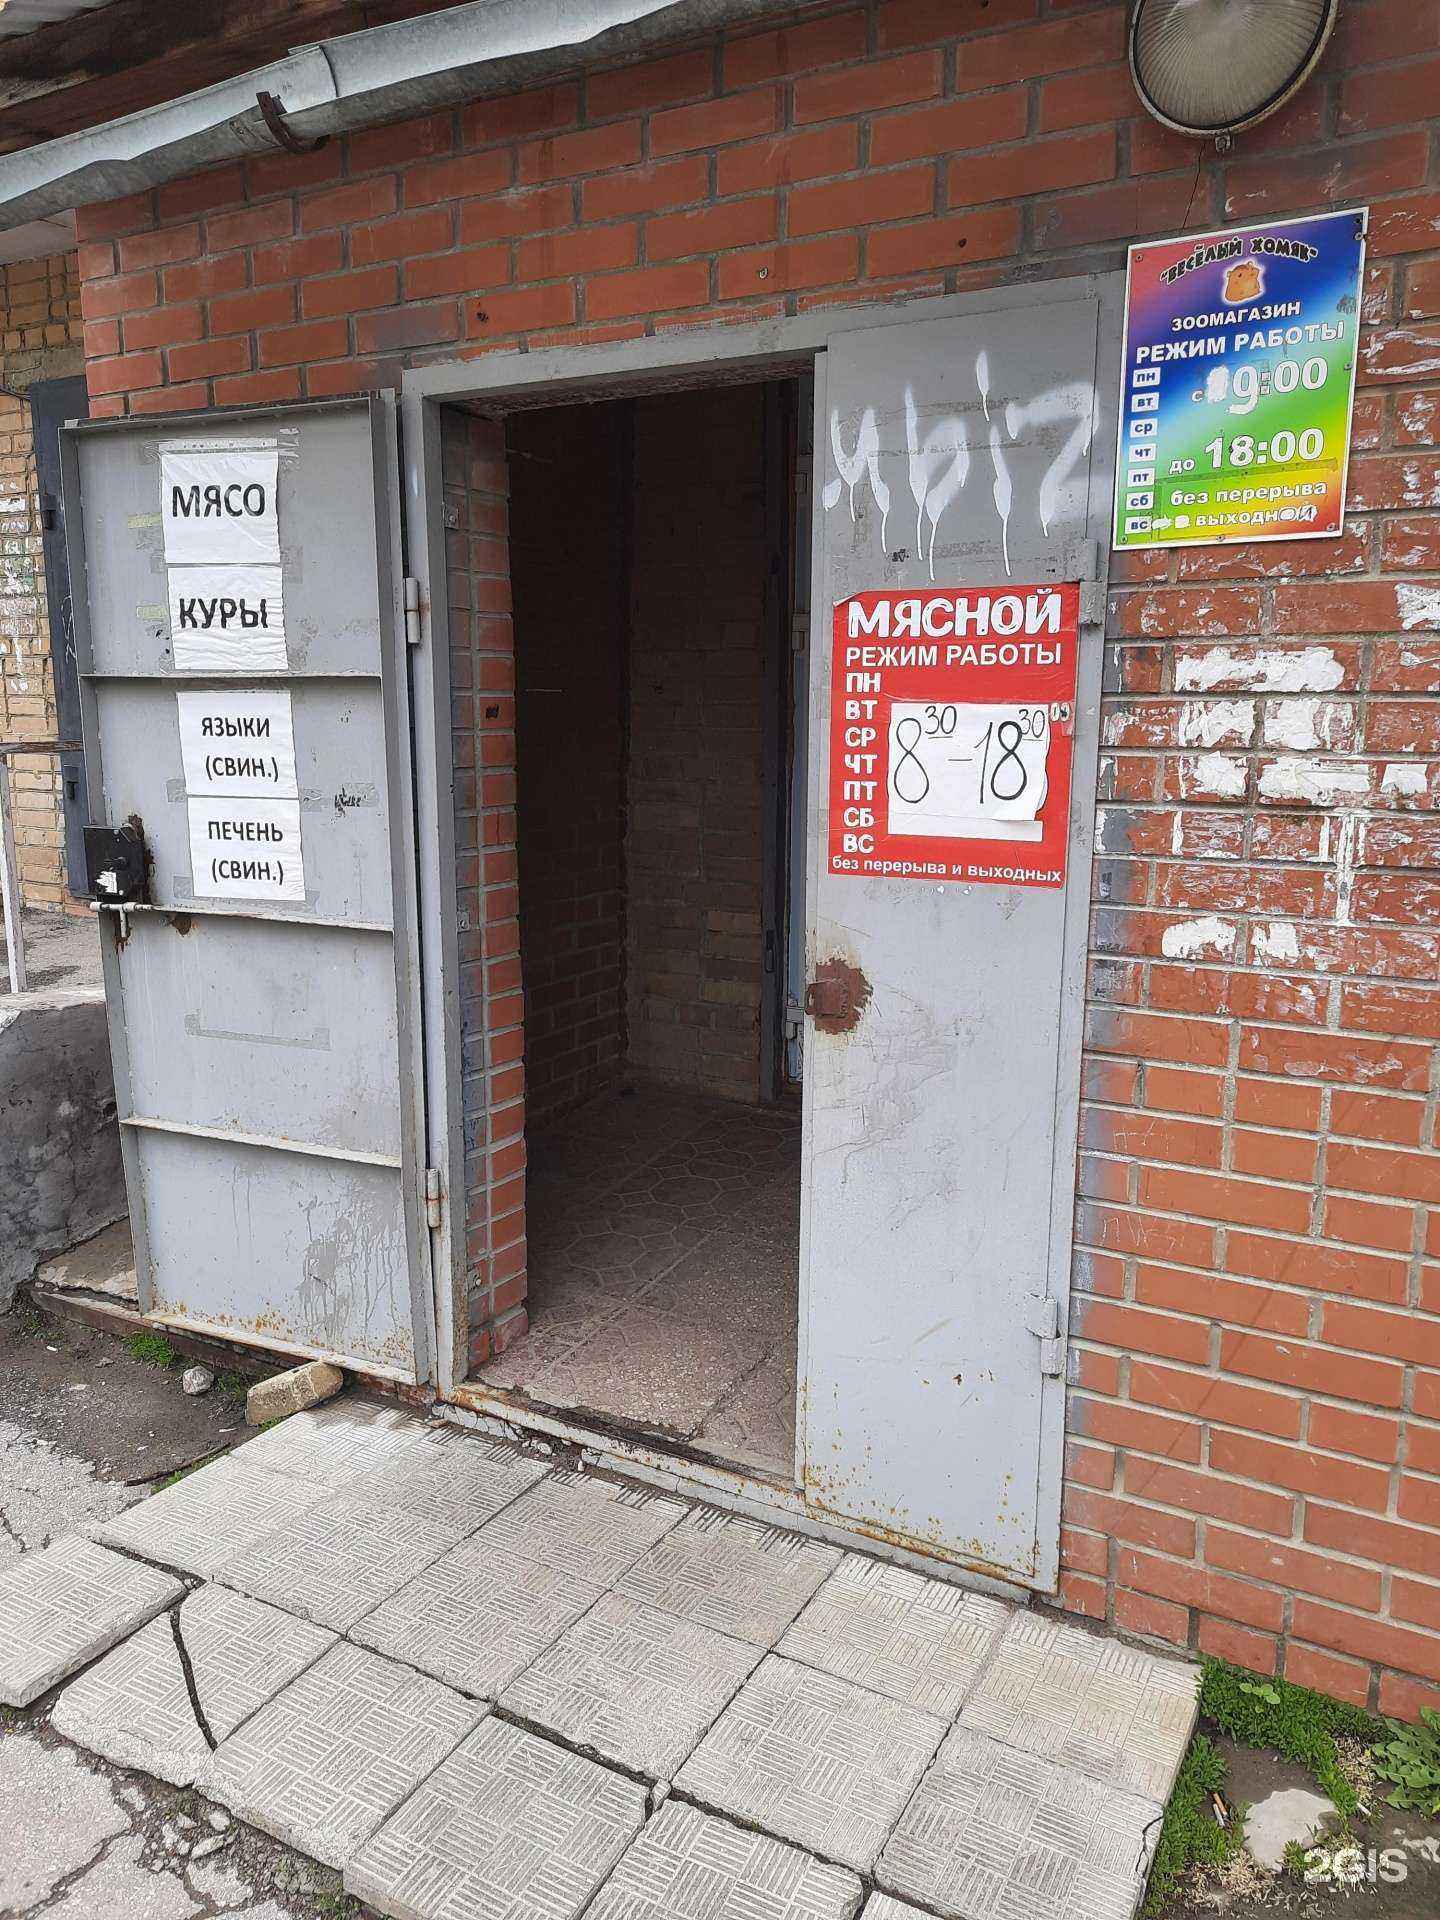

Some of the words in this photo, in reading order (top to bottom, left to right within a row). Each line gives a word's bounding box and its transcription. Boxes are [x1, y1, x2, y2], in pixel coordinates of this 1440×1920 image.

[1171, 298, 1302, 333] ЗООМАГАЗИН
[1136, 335, 1226, 365] РЕЖИМ
[1234, 320, 1345, 353] РАБОТЫ
[1169, 457, 1196, 476] до
[1204, 428, 1326, 470] 18:00
[172, 483, 266, 518] МЯСО
[1170, 489, 1210, 507] без
[1215, 482, 1329, 506] перерыва
[179, 598, 269, 629] КУРЫ
[847, 588, 1062, 639] МЯСНОЙ
[846, 645, 938, 668] РЕЖИМ
[946, 643, 1062, 667] РАБОТЫ
[845, 672, 882, 693] ПН
[845, 700, 879, 720] ВТ
[202, 717, 270, 738] ЯЗЫКИ
[844, 727, 877, 747] СР
[205, 755, 280, 783] (СВИН.)
[844, 754, 877, 774] ЧТ
[843, 780, 877, 800] ПТ
[843, 806, 876, 827] СБ
[208, 821, 283, 842] ПЕЧЕНЬ
[843, 833, 875, 853] ВС
[212, 858, 284, 886] (СВИН.)
[832, 855, 859, 871] без
[864, 859, 947, 876] перерыва
[952, 865, 962, 875] и
[967, 865, 1062, 883] выходных
